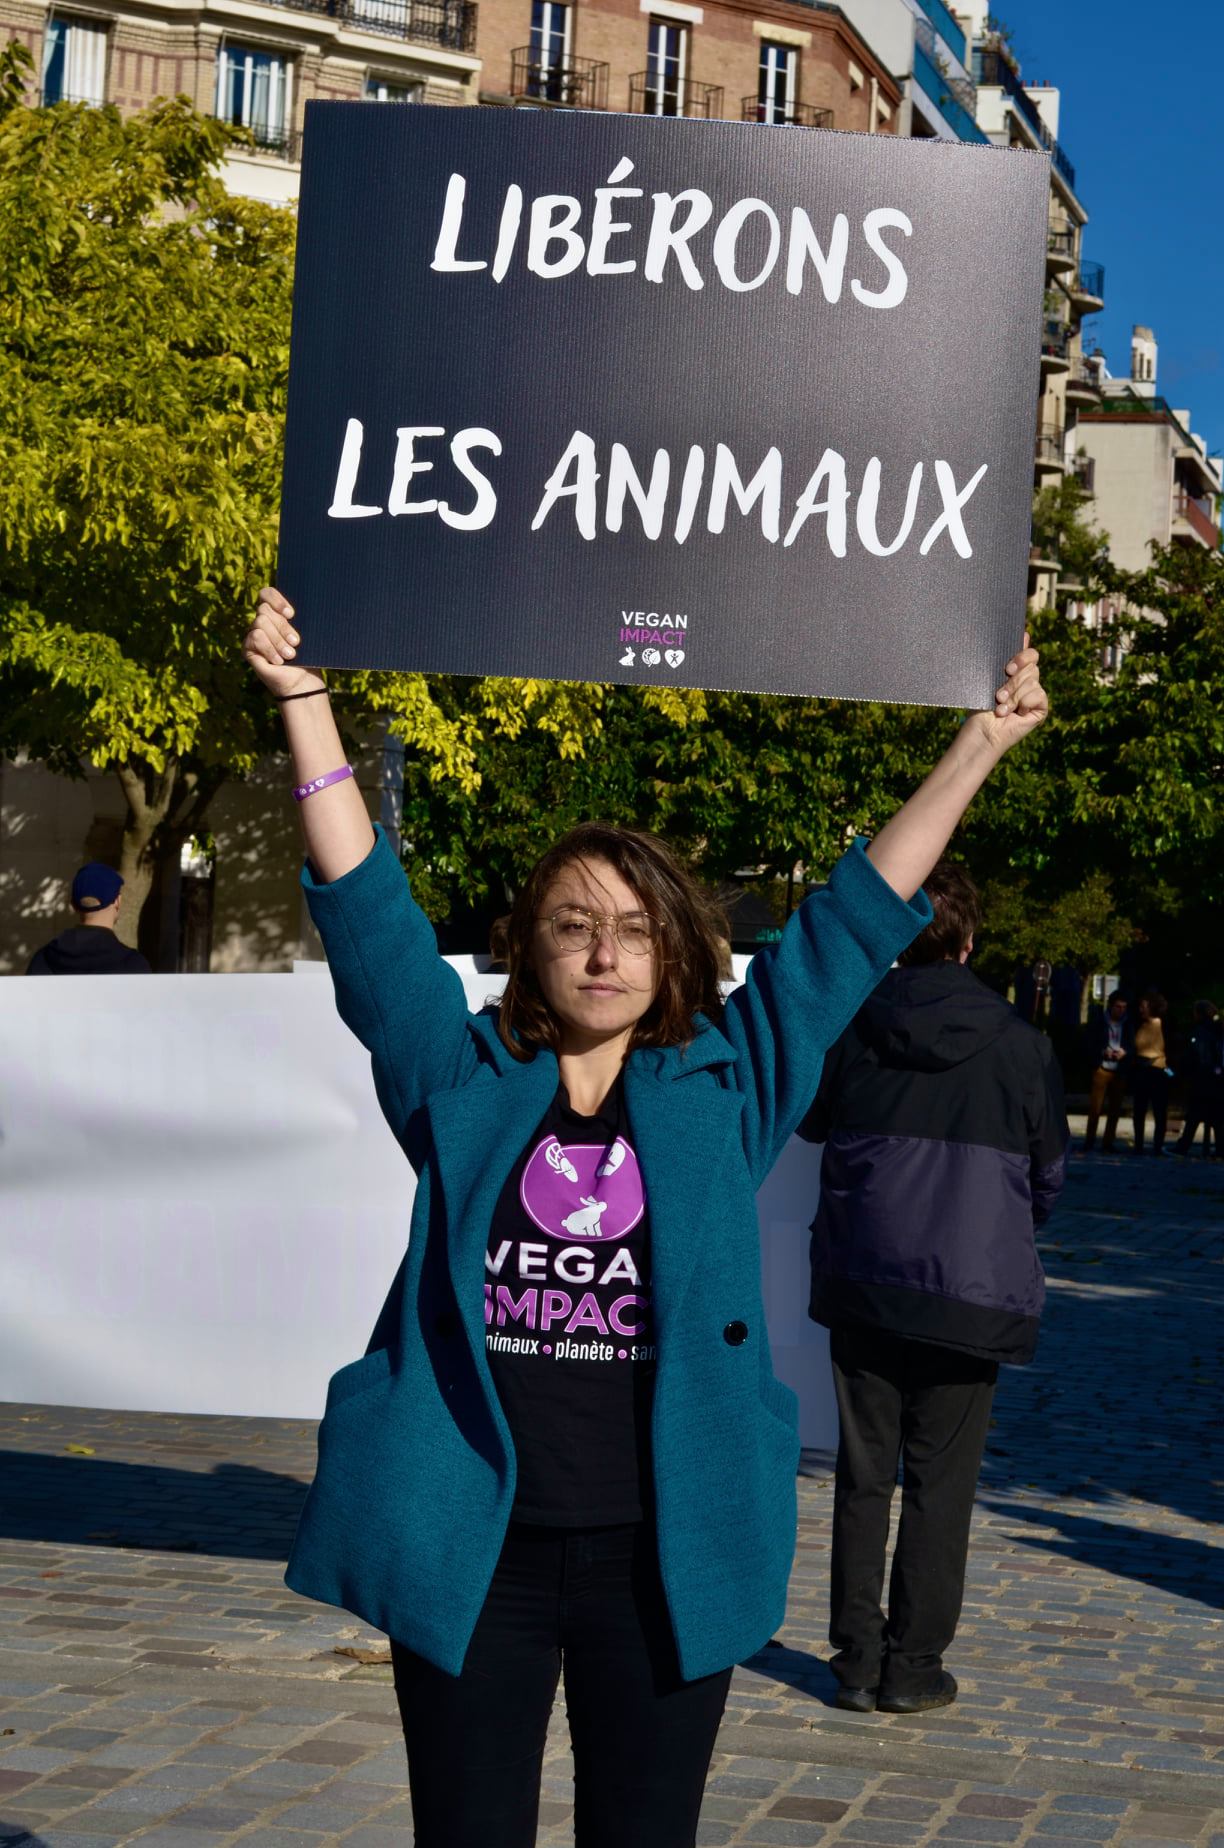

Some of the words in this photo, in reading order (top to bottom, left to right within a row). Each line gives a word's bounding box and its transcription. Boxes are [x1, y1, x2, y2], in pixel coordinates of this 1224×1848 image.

[430, 156, 915, 310] LIBÉRONS
[327, 417, 503, 532] LES
[531, 430, 989, 560] ANIMAUX
[619, 628, 687, 646] IMPACT
[621, 610, 688, 628] VEGAN
[484, 1240, 652, 1287] VEGA
[484, 1284, 649, 1337] IMPAC
[485, 1331, 540, 1356] nimaux
[555, 1338, 614, 1361] planète
[631, 1343, 656, 1362] san
